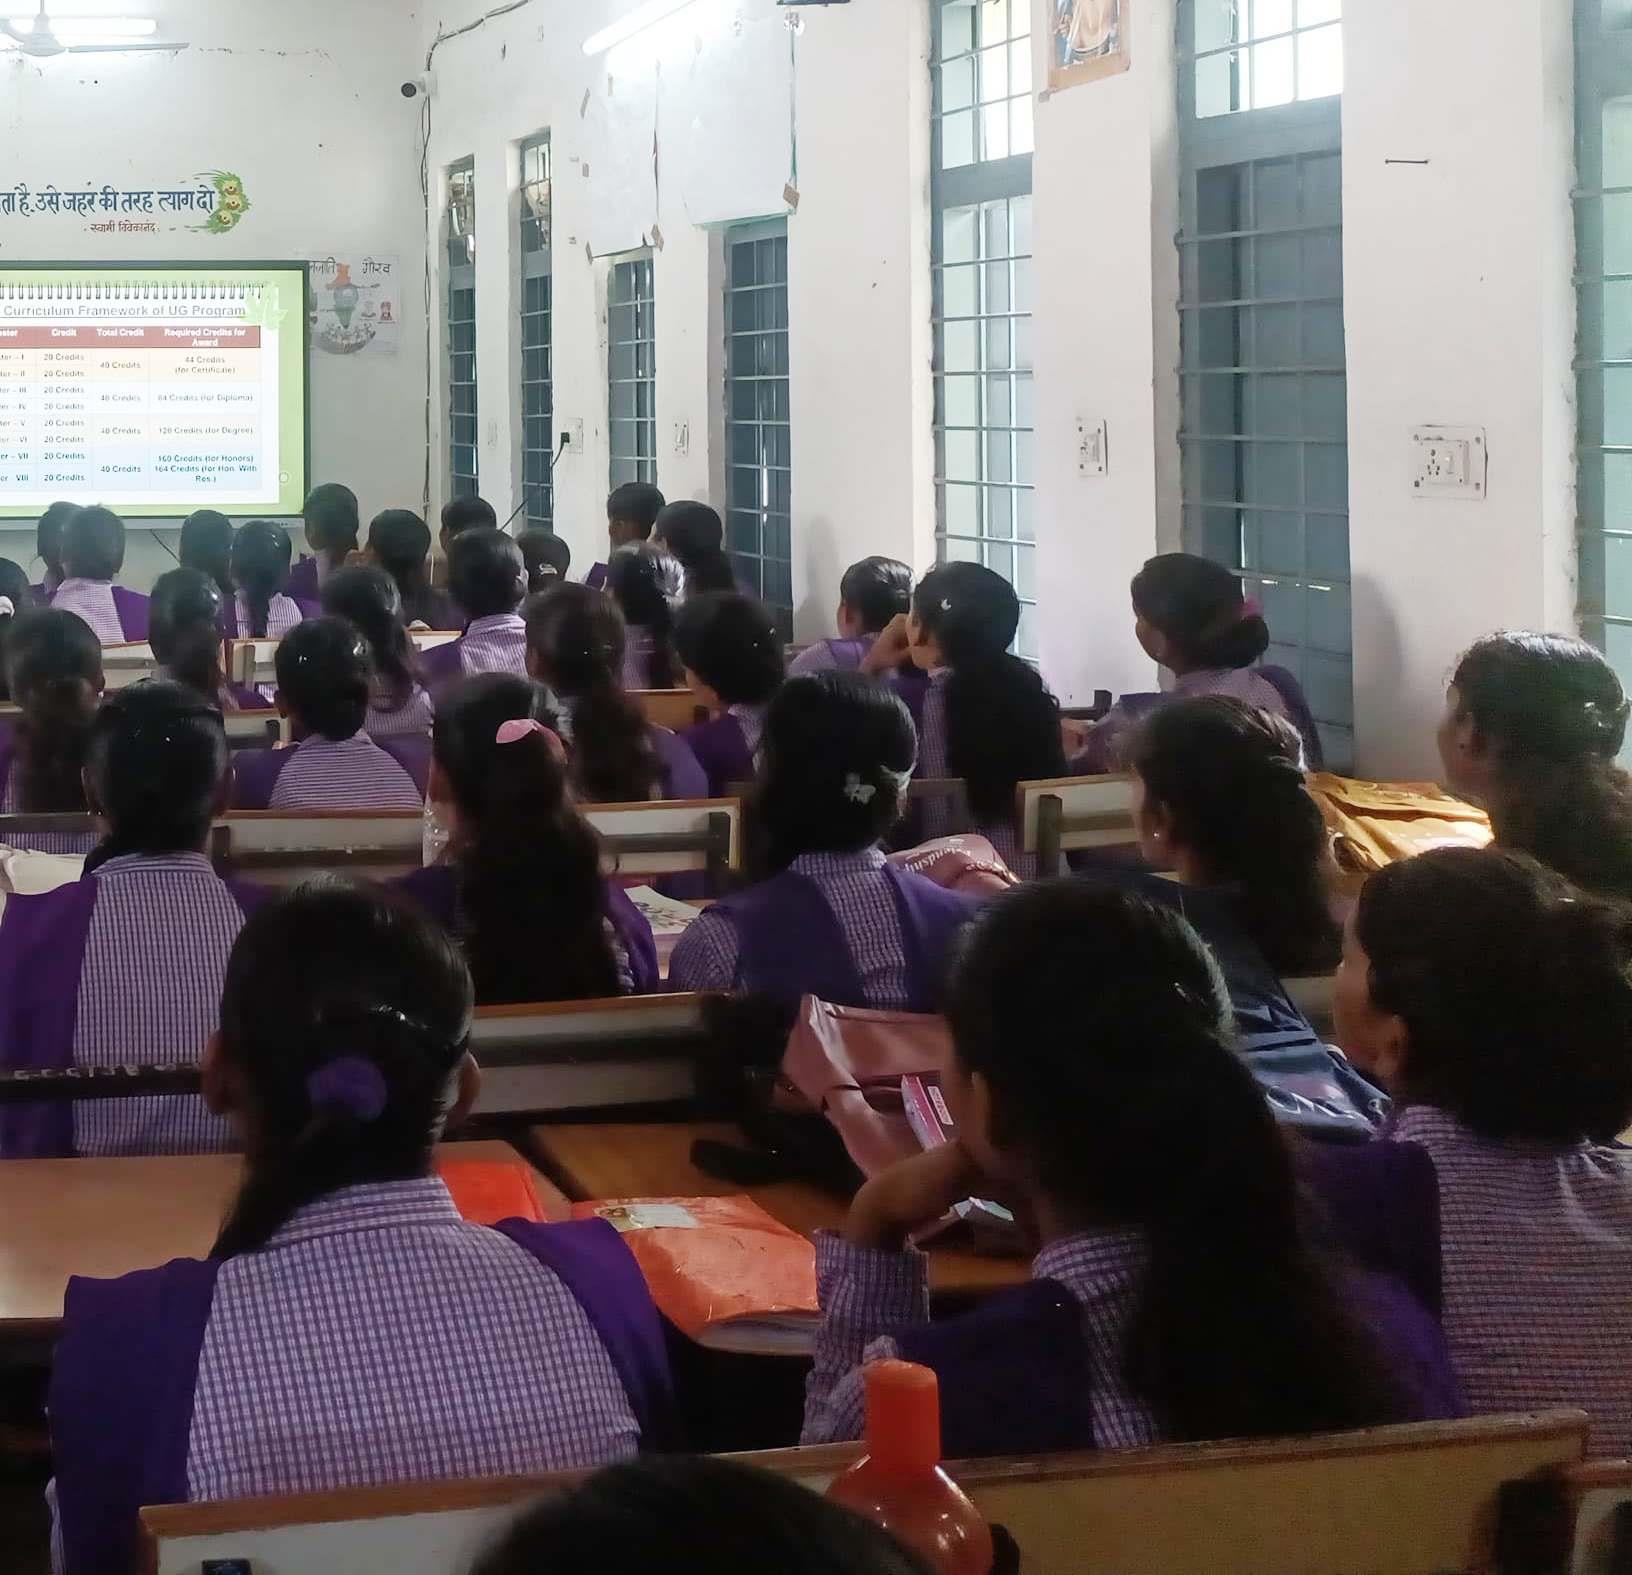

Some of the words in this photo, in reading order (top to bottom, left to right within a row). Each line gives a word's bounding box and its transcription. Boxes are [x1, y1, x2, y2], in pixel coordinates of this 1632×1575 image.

[36, 185, 61, 214] उसे
[63, 192, 98, 217] जहर
[99, 185, 119, 212] की
[121, 191, 154, 215] तरह
[157, 191, 195, 211] त्याग
[196, 185, 216, 214] दो
[4, 306, 74, 316] Curriculum
[79, 306, 148, 316] Framework
[152, 305, 165, 316] of
[169, 306, 188, 316] UG
[192, 306, 246, 318] Program
[51, 329, 77, 337] Credit
[96, 328, 117, 337] Total
[118, 328, 144, 337] Credit
[164, 328, 201, 338] Required
[203, 328, 232, 337] Credits
[234, 328, 246, 337] for
[192, 339, 218, 347] Award
